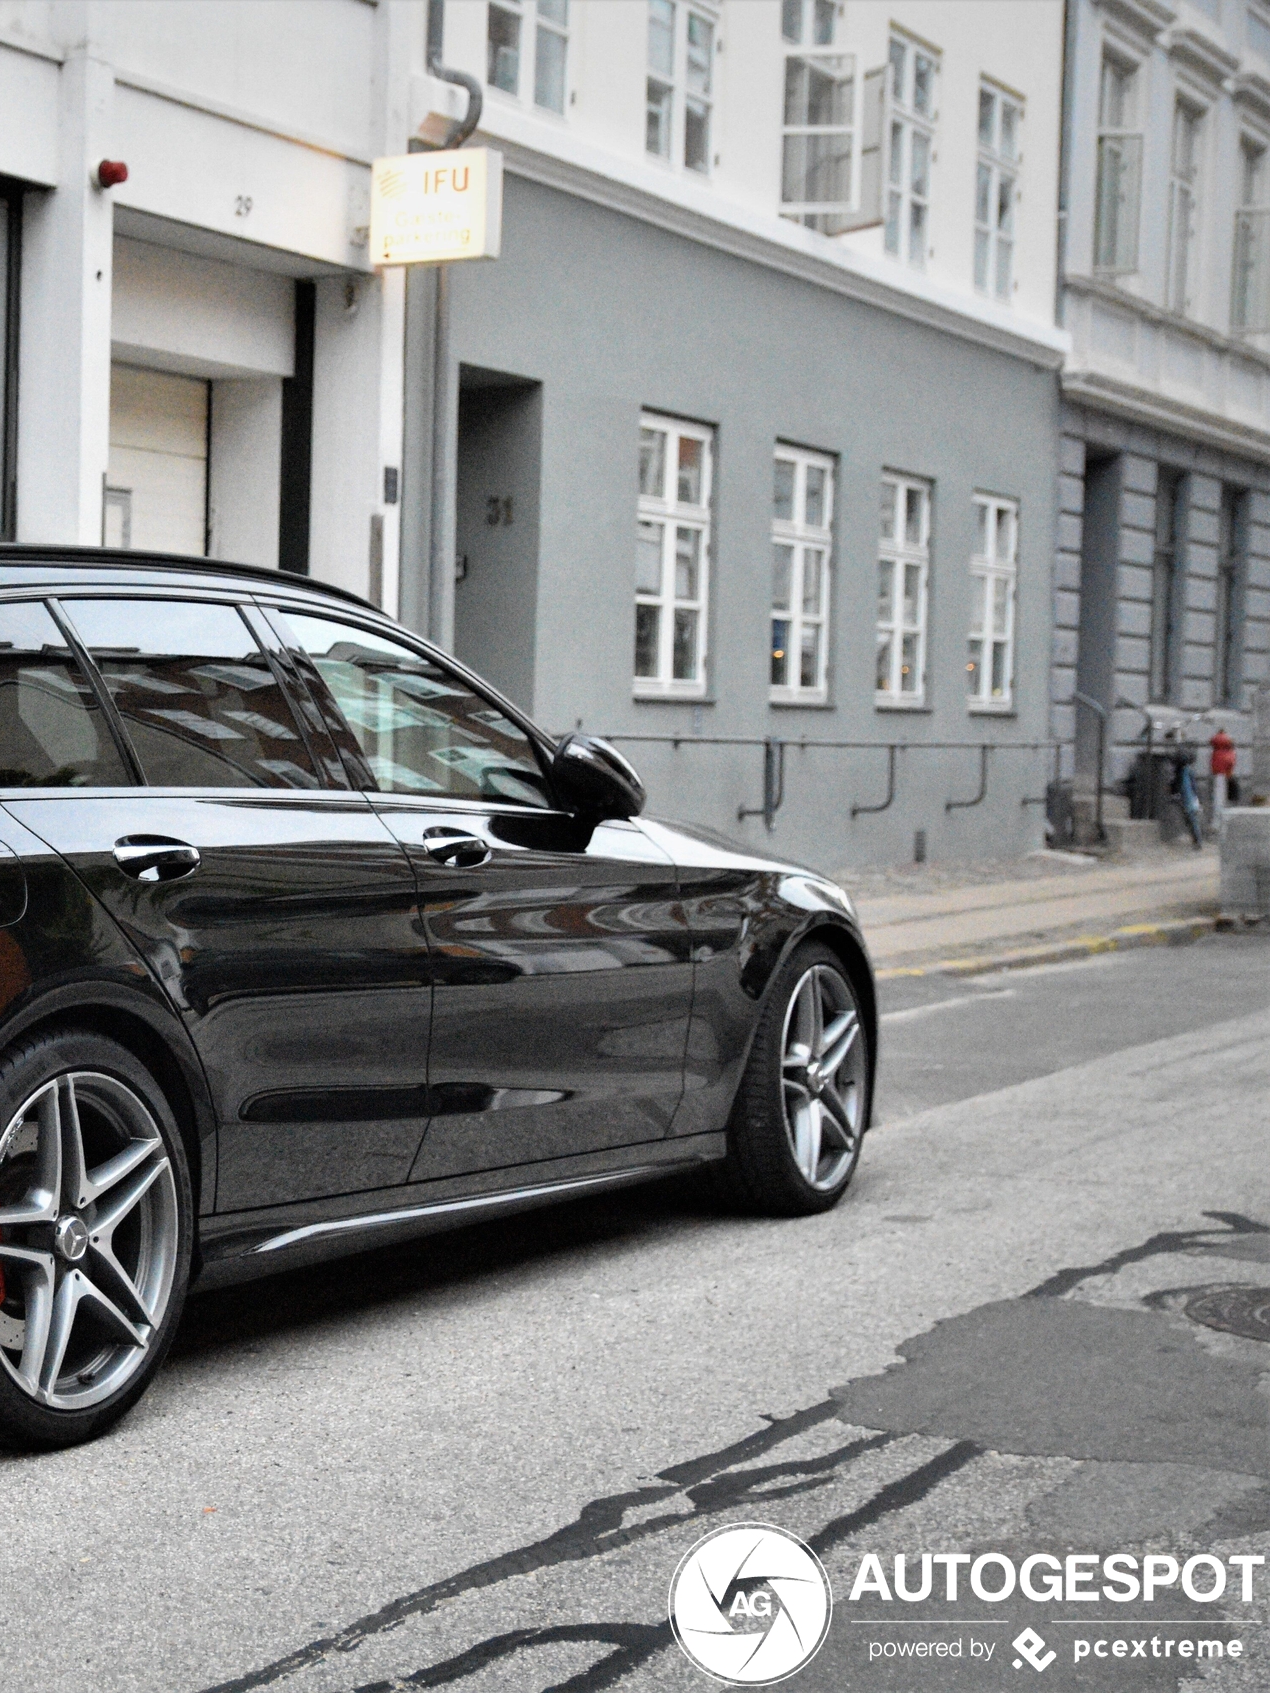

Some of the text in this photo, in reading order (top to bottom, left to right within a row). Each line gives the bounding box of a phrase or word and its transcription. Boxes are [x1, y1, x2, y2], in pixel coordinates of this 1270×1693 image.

[423, 166, 469, 195] IFU
[234, 194, 254, 218] 29
[383, 227, 472, 251] parkering
[486, 496, 514, 526] 31
